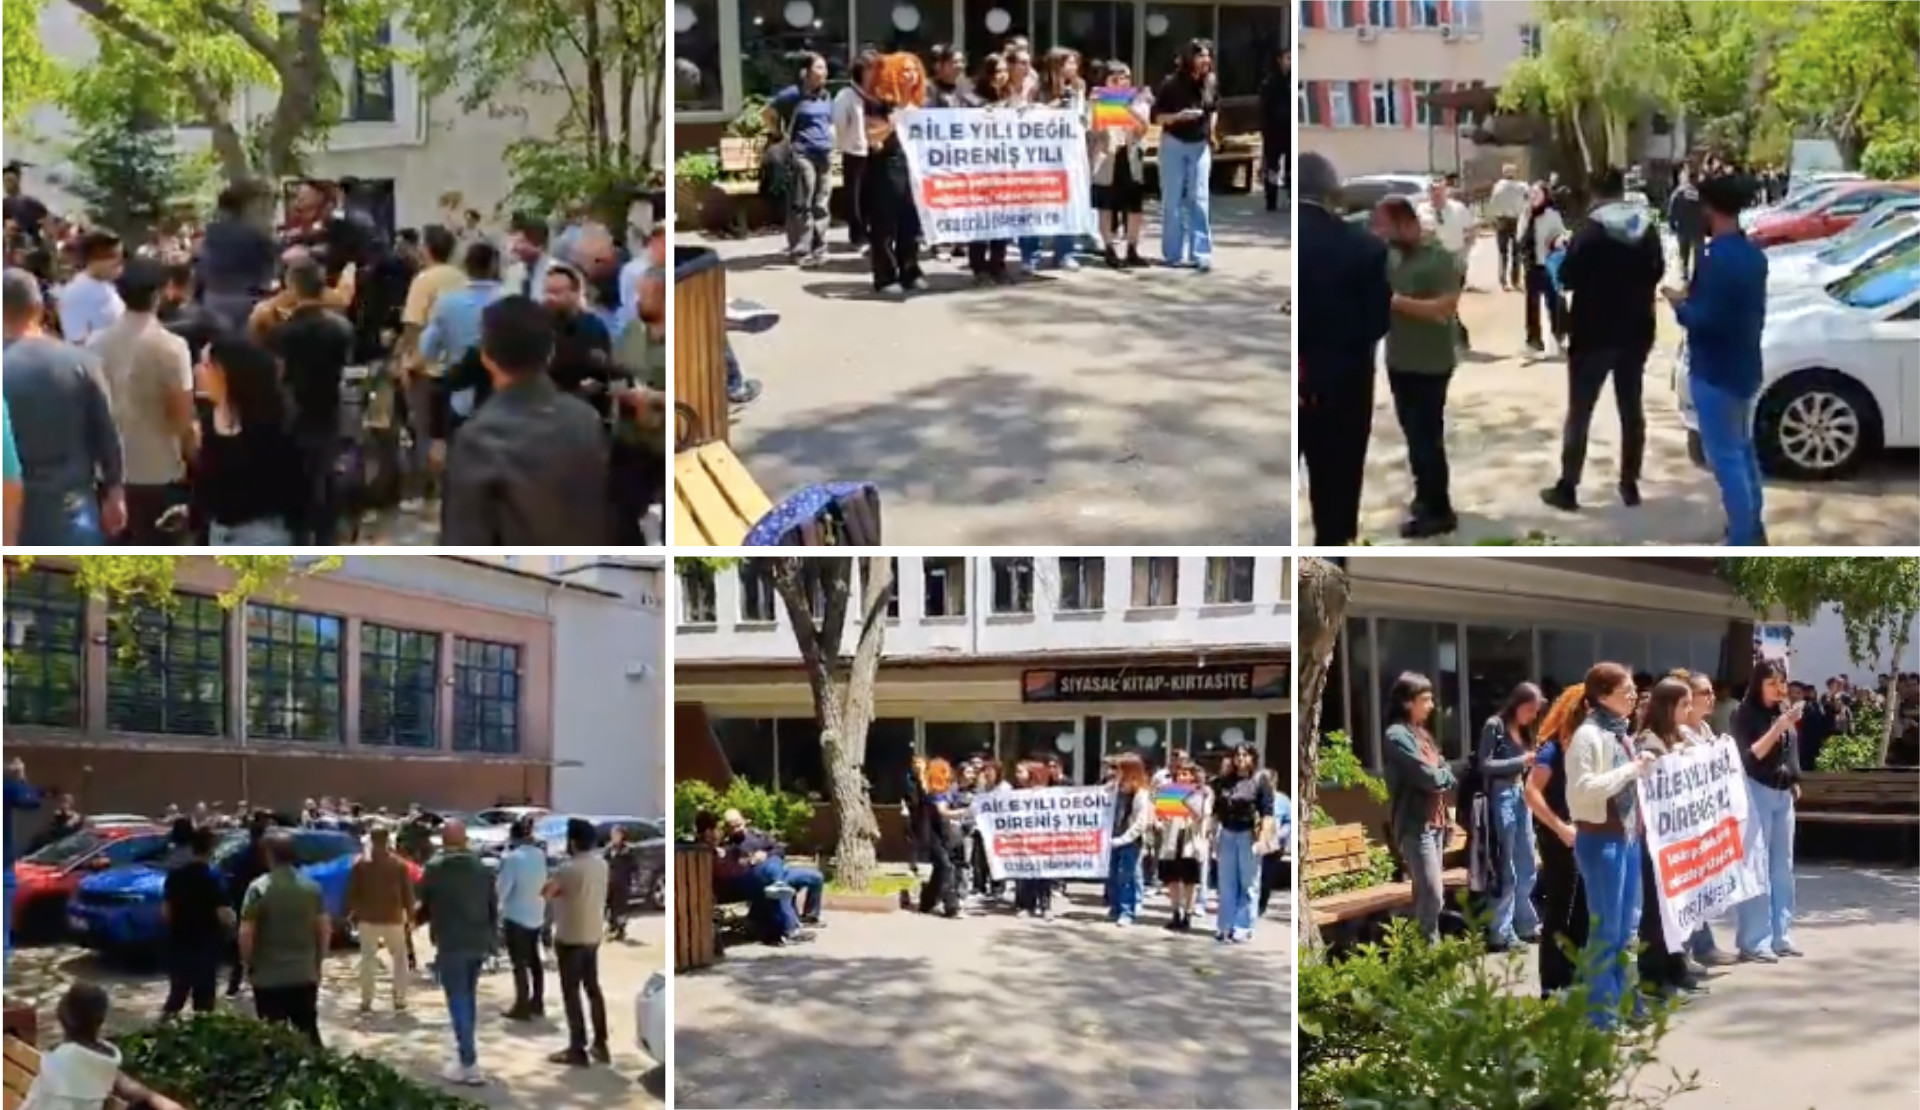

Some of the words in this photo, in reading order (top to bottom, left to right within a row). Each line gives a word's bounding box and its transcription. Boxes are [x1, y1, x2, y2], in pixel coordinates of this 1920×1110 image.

[908, 117, 964, 141] AİLE
[969, 123, 1012, 139] YILI
[1018, 116, 1077, 139] DEĞİL
[928, 142, 1020, 168] DİRENİŞ
[1024, 146, 1063, 163] YILI
[1060, 674, 1119, 693] SİYASAL
[1645, 768, 1682, 801] AİLE
[981, 798, 1020, 813] AİLE
[1022, 797, 1055, 811] YILI
[1059, 795, 1112, 809] DEĞİL
[994, 812, 1062, 831] DİRENİŞ
[1067, 813, 1098, 827] YILI
